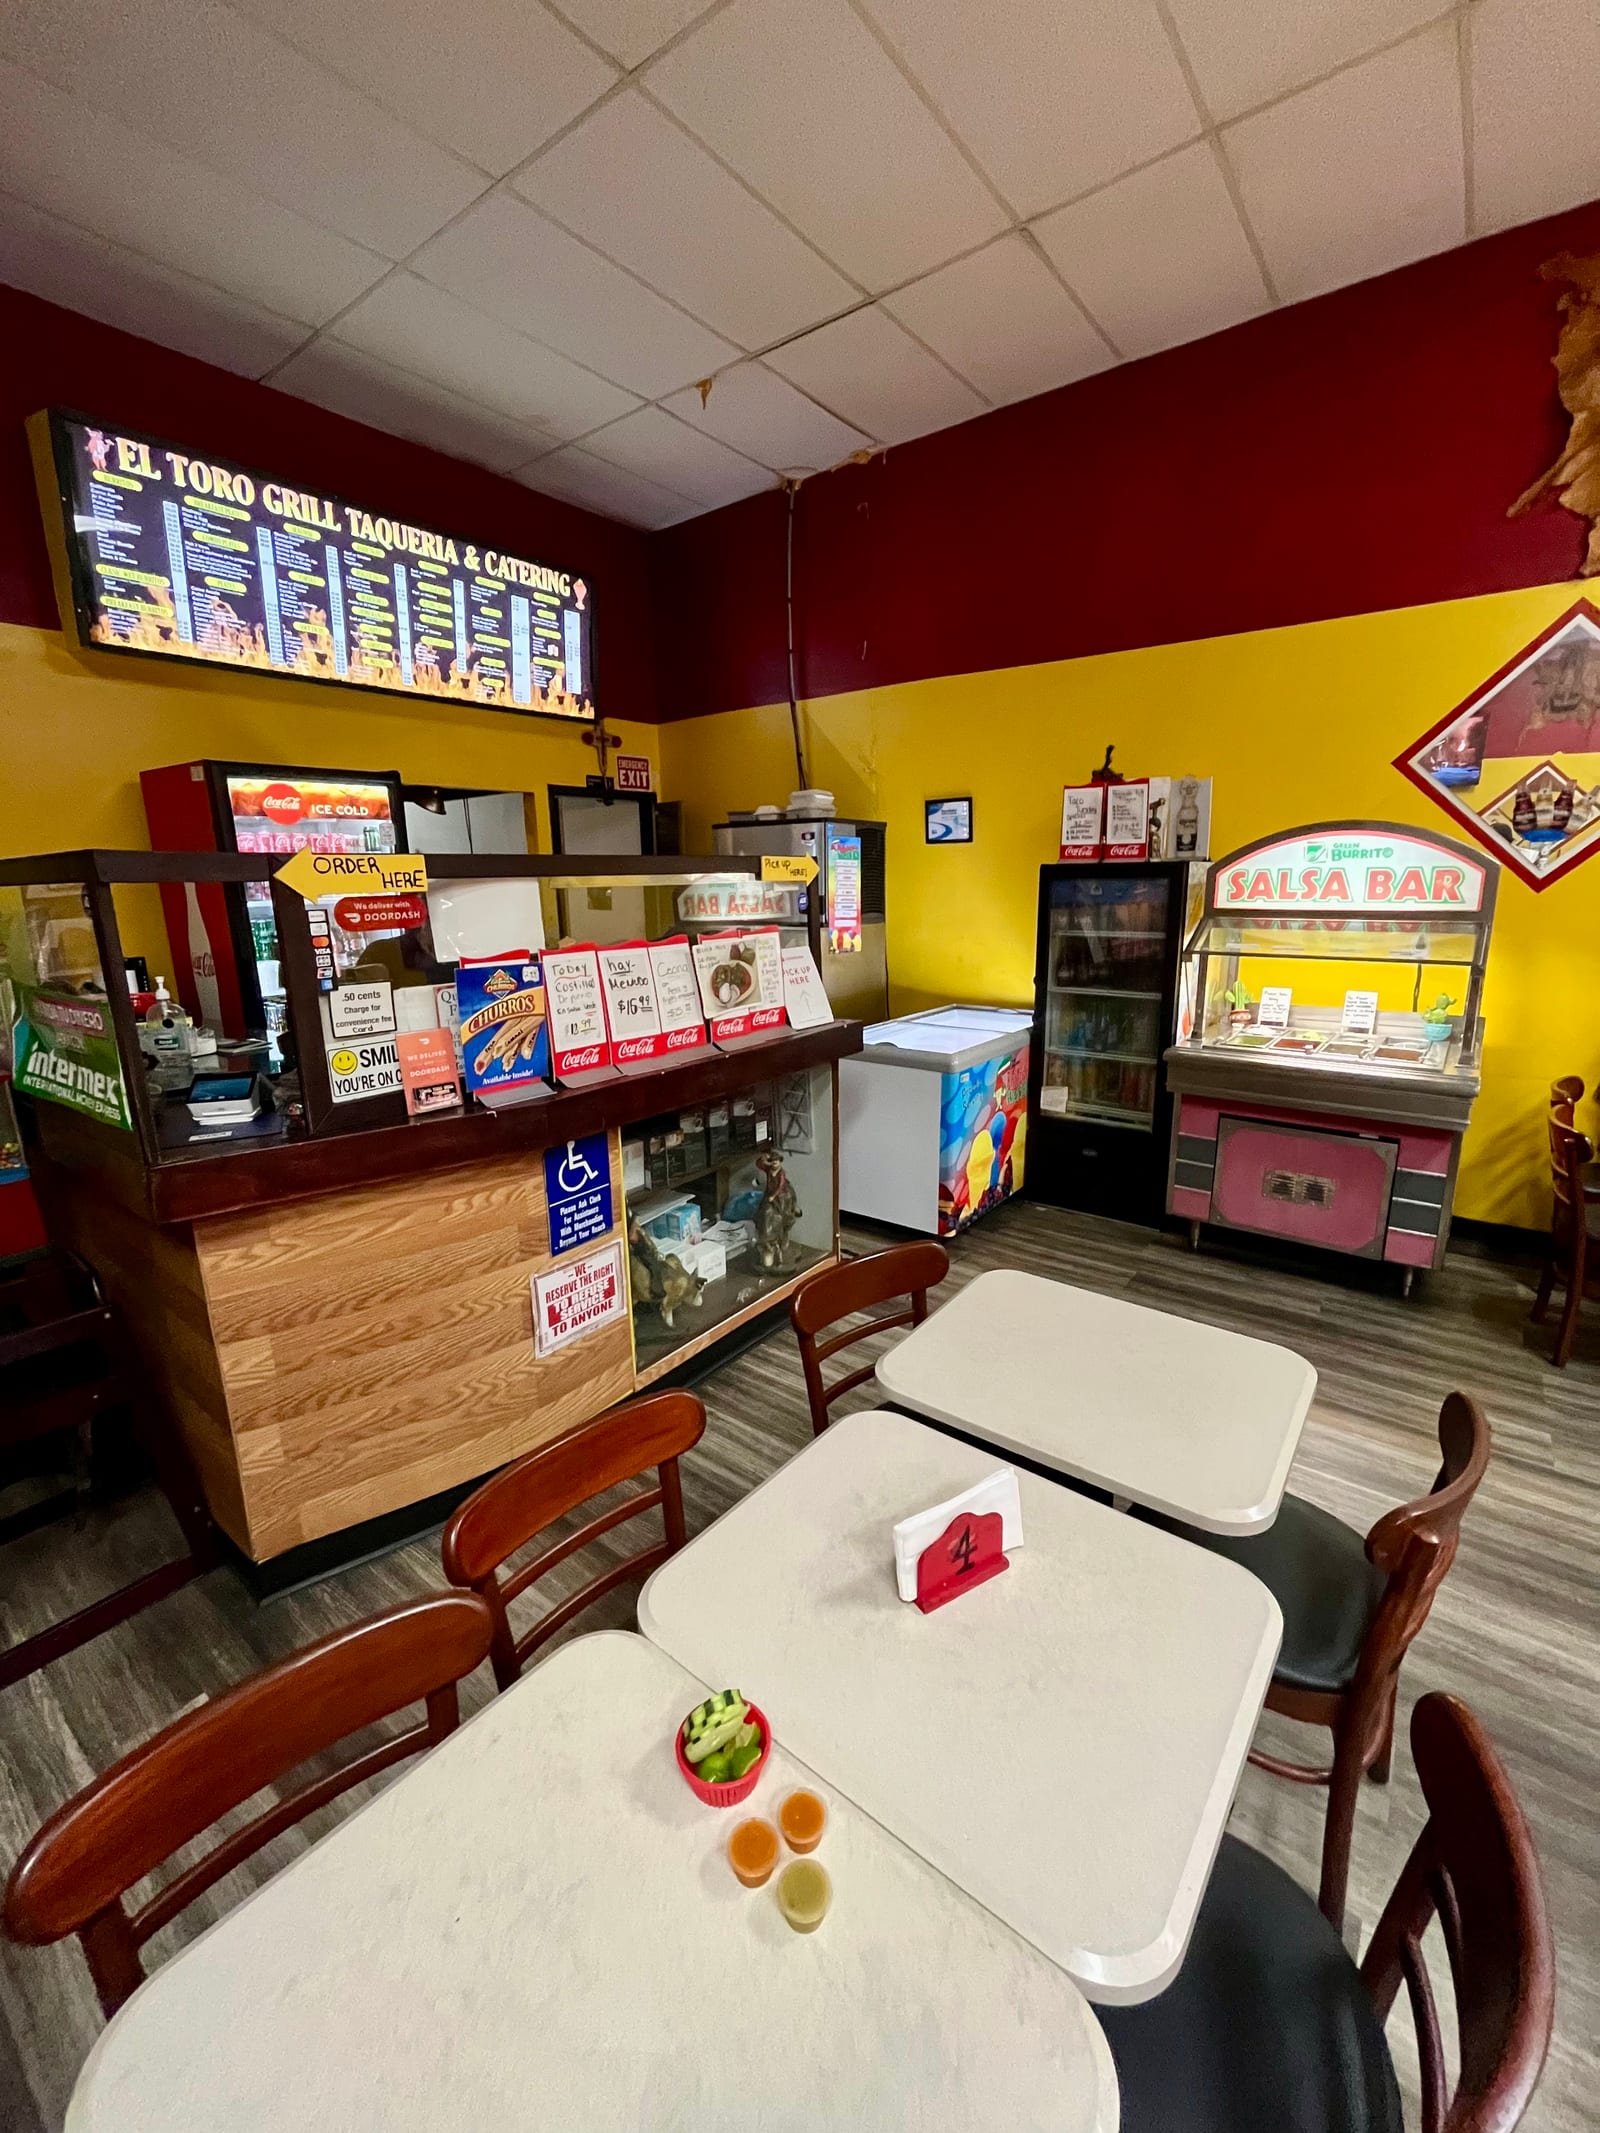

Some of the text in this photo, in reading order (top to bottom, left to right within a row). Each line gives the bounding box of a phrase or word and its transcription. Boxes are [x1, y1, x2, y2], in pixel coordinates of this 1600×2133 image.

[115, 437, 571, 597] EL TORO GRILL TAQUERIA & CATERING
[618, 759, 648, 770] EMERGENCY
[619, 769, 649, 787] EXIT
[263, 796, 301, 810] Coca-Cola
[311, 804, 369, 816] ICE COLD
[1331, 847, 1394, 863] BURRITO
[313, 856, 381, 875] ORDER
[381, 869, 425, 889] HERE
[1227, 866, 1466, 904] SALSA BAR
[353, 901, 410, 910] We deliver with
[364, 911, 421, 922] DOORDASH
[789, 975, 810, 985] HERE
[357, 991, 381, 1000] cents
[344, 1005, 369, 1015] Charge
[469, 995, 535, 1034] CHURROS
[752, 1009, 780, 1026] Coca-Cola
[336, 1018, 380, 1028] convenience
[352, 1025, 374, 1033] Card
[717, 1017, 745, 1037] Coca-Cola
[667, 1028, 698, 1048] Coca-Cola
[359, 1045, 400, 1068] SMIL
[419, 1050, 447, 1060] DELIVER
[619, 1038, 655, 1059] Coca-Cola
[562, 1048, 600, 1070] Coca-Cola
[27, 1041, 120, 1106] intermex
[409, 1065, 450, 1078] DOORDASH
[483, 1073, 512, 1085] Available
[335, 1076, 376, 1096] YOU'RE
[377, 1070, 394, 1086] ON
[560, 1205, 577, 1216] Please
[578, 1199, 587, 1208] Ask
[564, 1217, 572, 1225] For
[575, 1263, 586, 1277] WE
[546, 1262, 614, 1304] RESERVE THE RIGHT
[554, 1279, 610, 1315] TO REFUSE
[560, 1292, 605, 1319] SERVICE
[552, 1298, 614, 1337] TO ANYONE
[952, 1524, 978, 1576] 4
